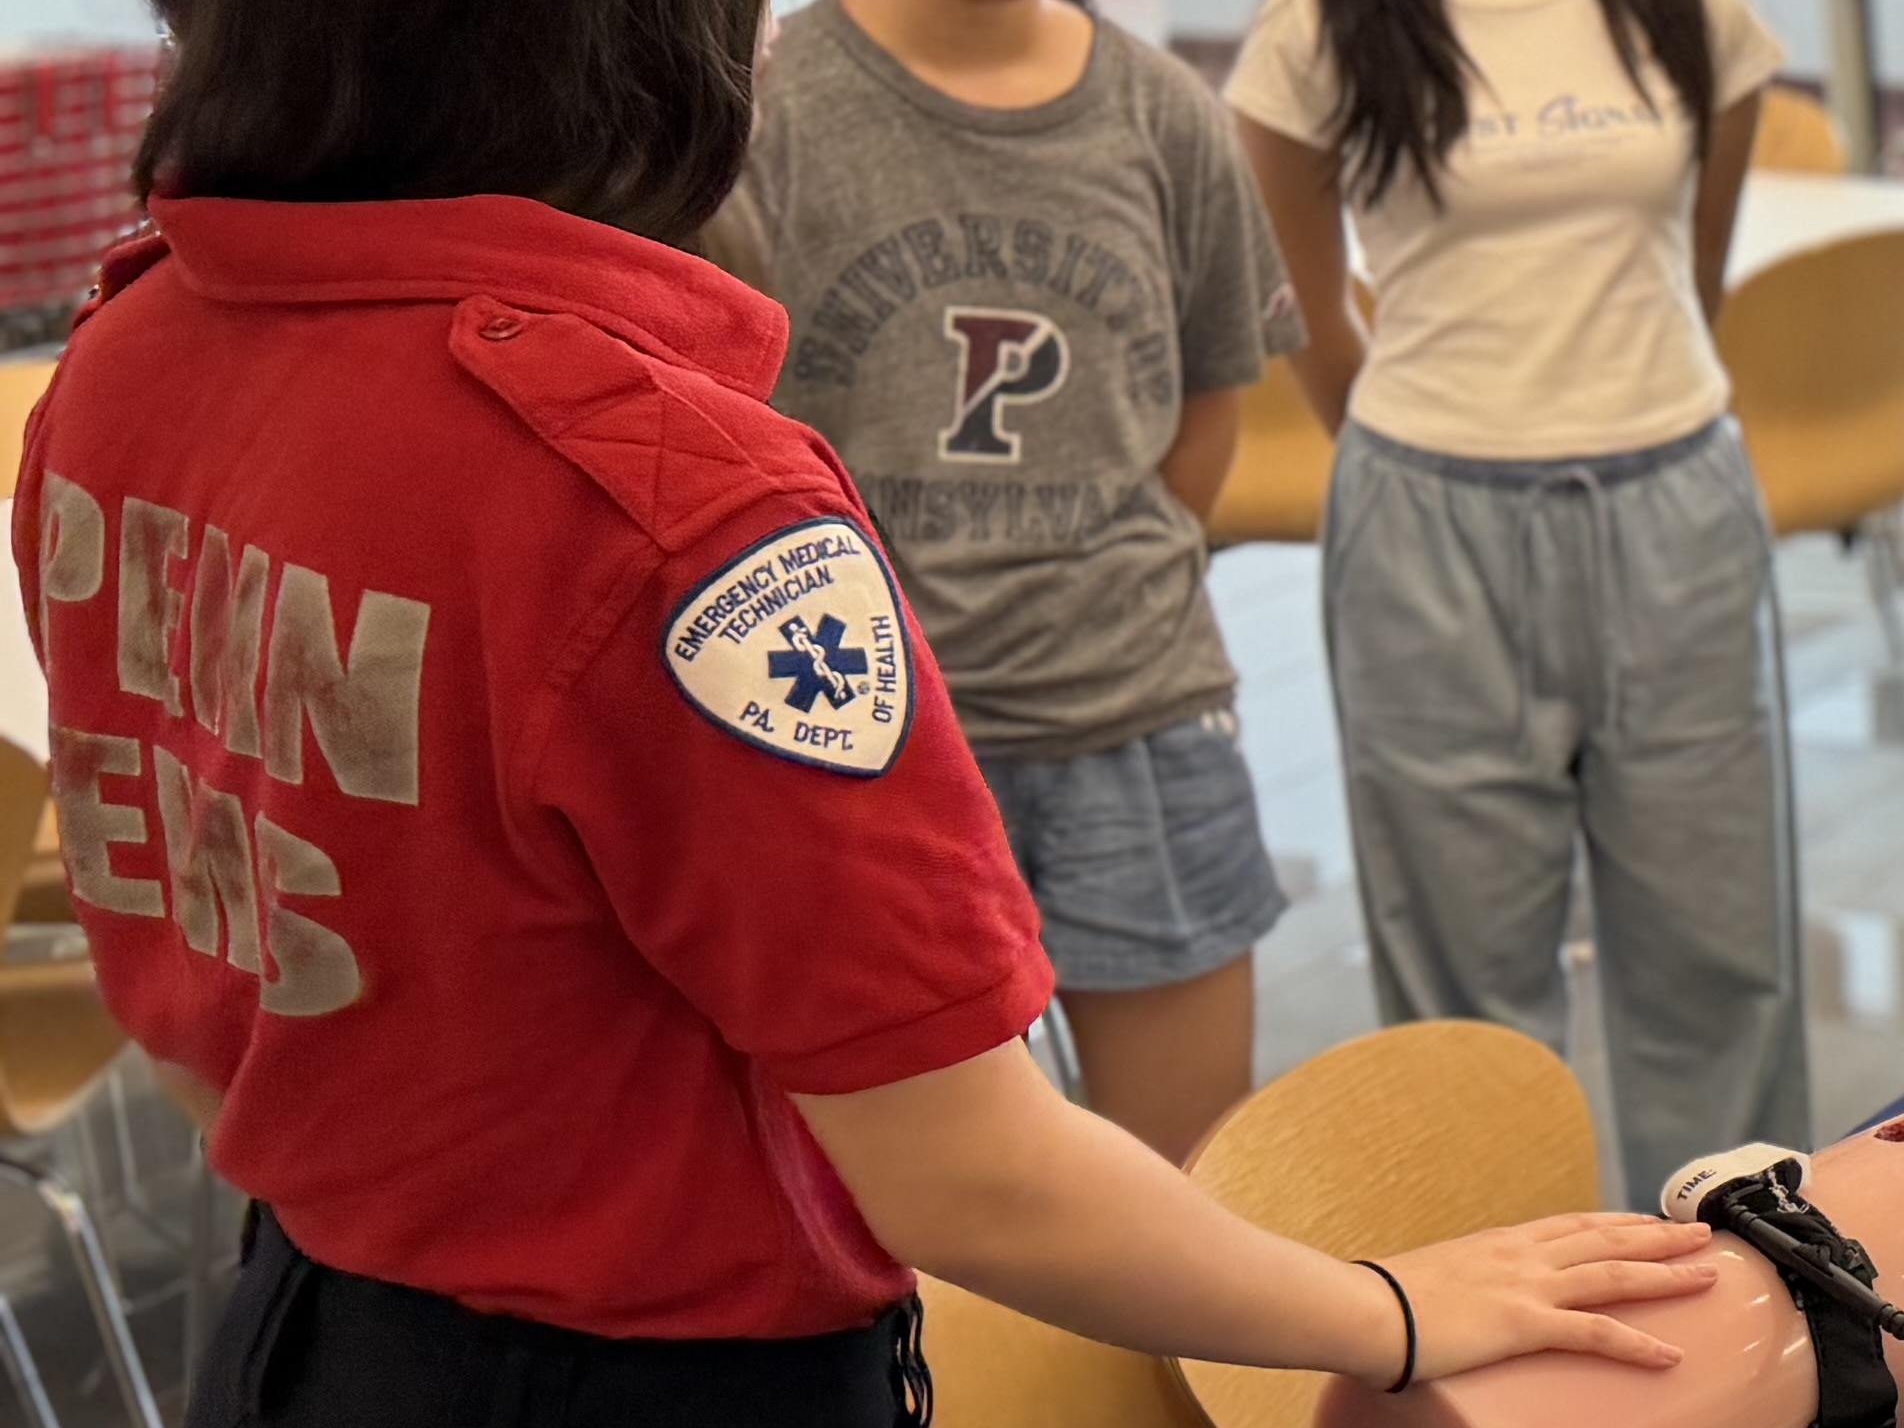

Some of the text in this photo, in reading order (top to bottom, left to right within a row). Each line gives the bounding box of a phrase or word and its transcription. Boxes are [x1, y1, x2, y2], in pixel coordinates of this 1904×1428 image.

[938, 306, 1071, 464] P
[40, 470, 431, 806] PENN
[674, 535, 861, 663] EMERGENCY MEDICAL
[718, 565, 835, 645] TECHNICIAN
[870, 615, 897, 724] OF HEALTH
[793, 721, 854, 751] DEPT.
[50, 727, 362, 1016] EMS
